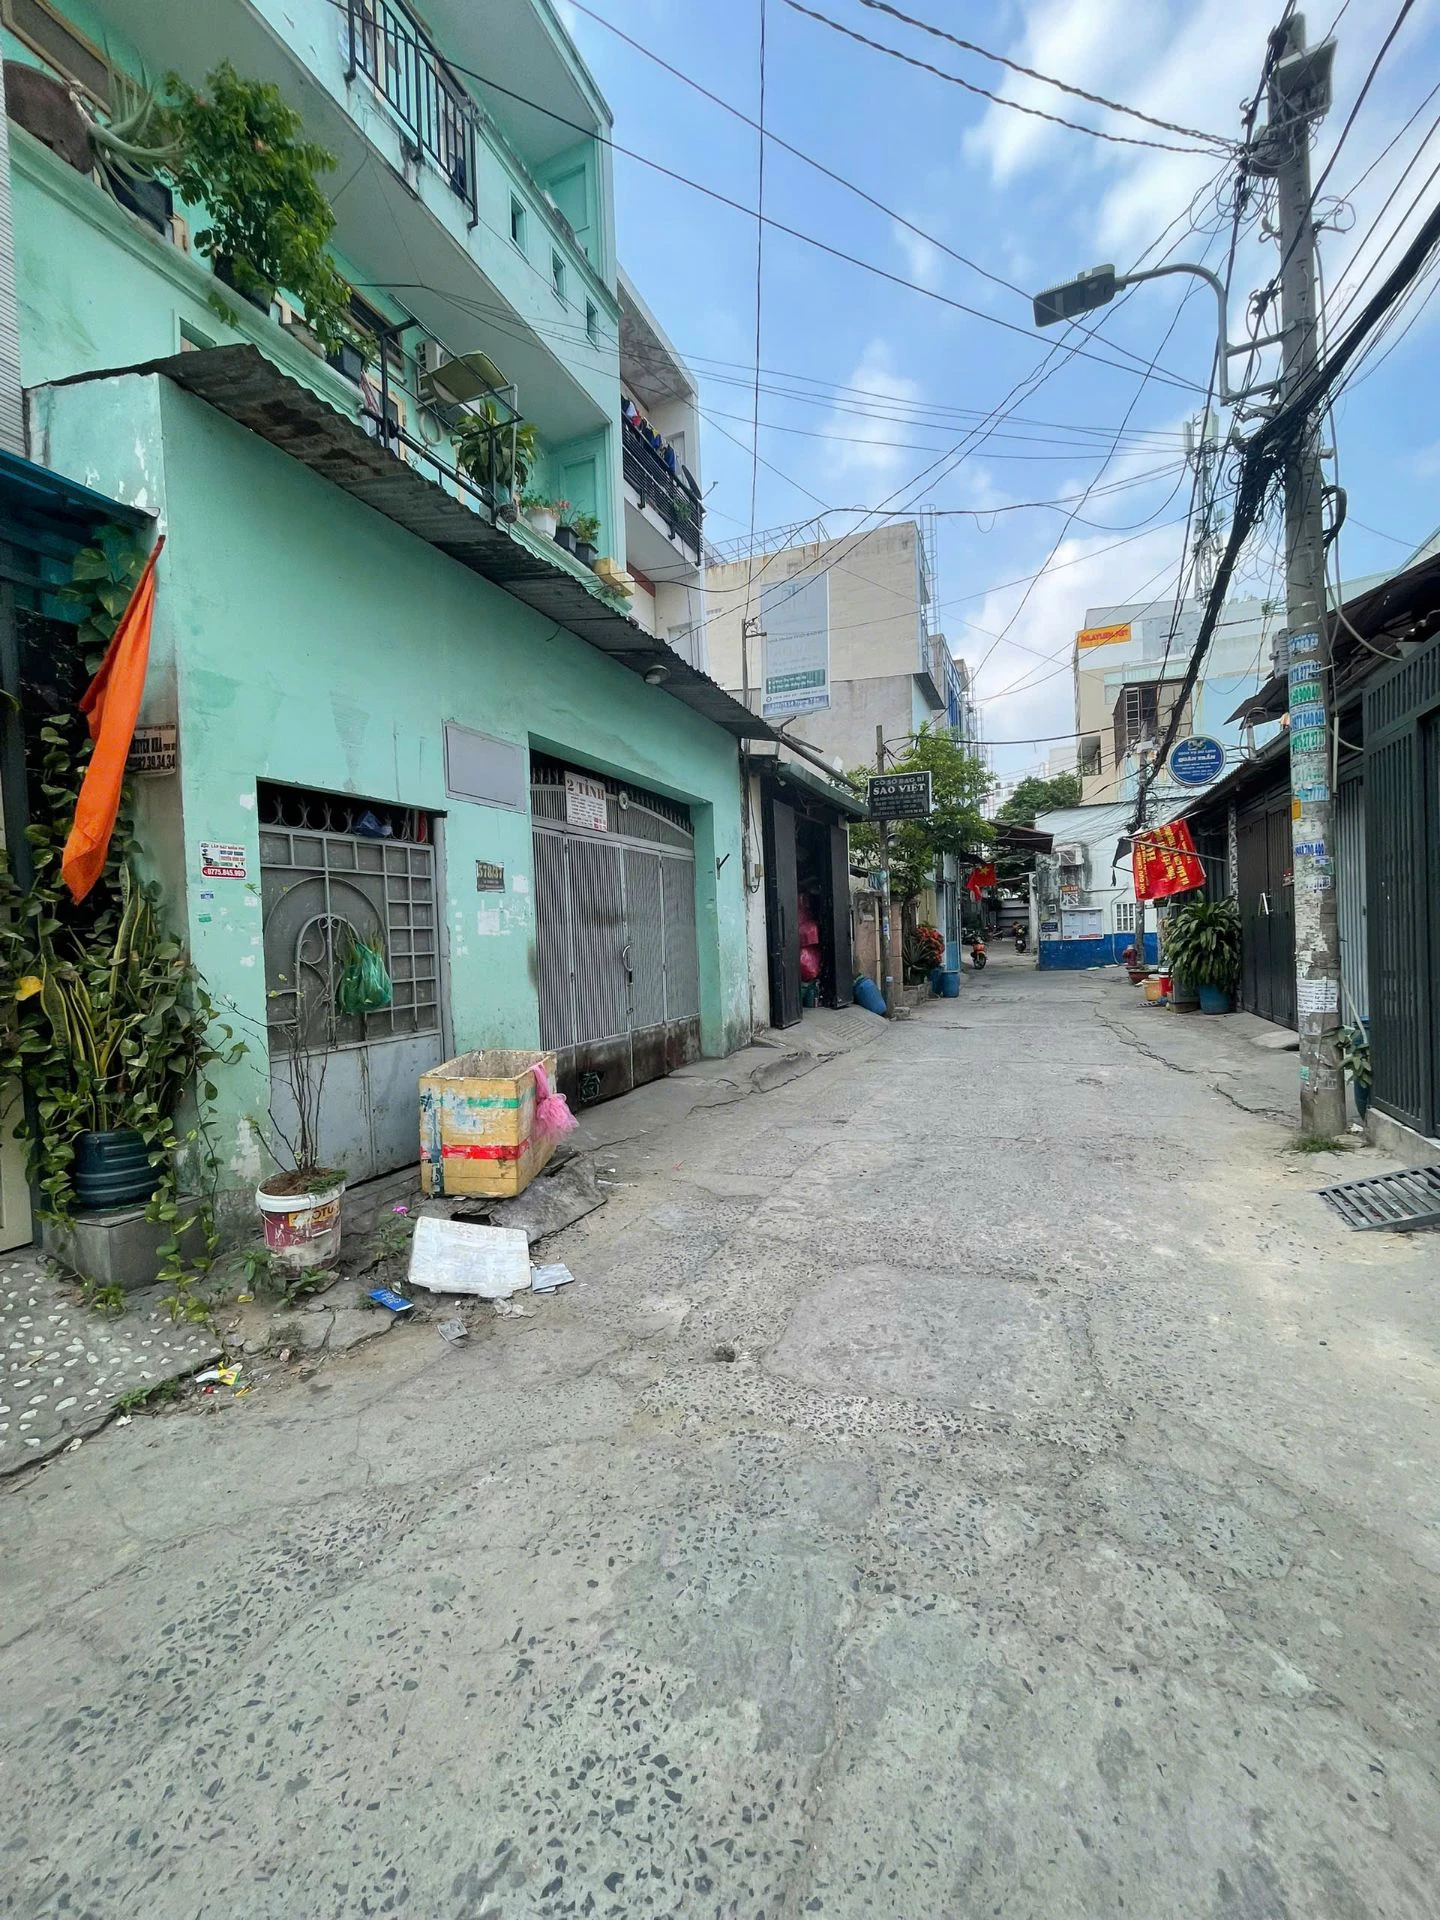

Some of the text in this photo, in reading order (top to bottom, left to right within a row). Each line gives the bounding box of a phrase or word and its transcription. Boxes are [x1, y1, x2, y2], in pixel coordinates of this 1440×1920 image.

[567, 779, 575, 791] 2
[873, 782, 926, 795] SAO VIỆT
